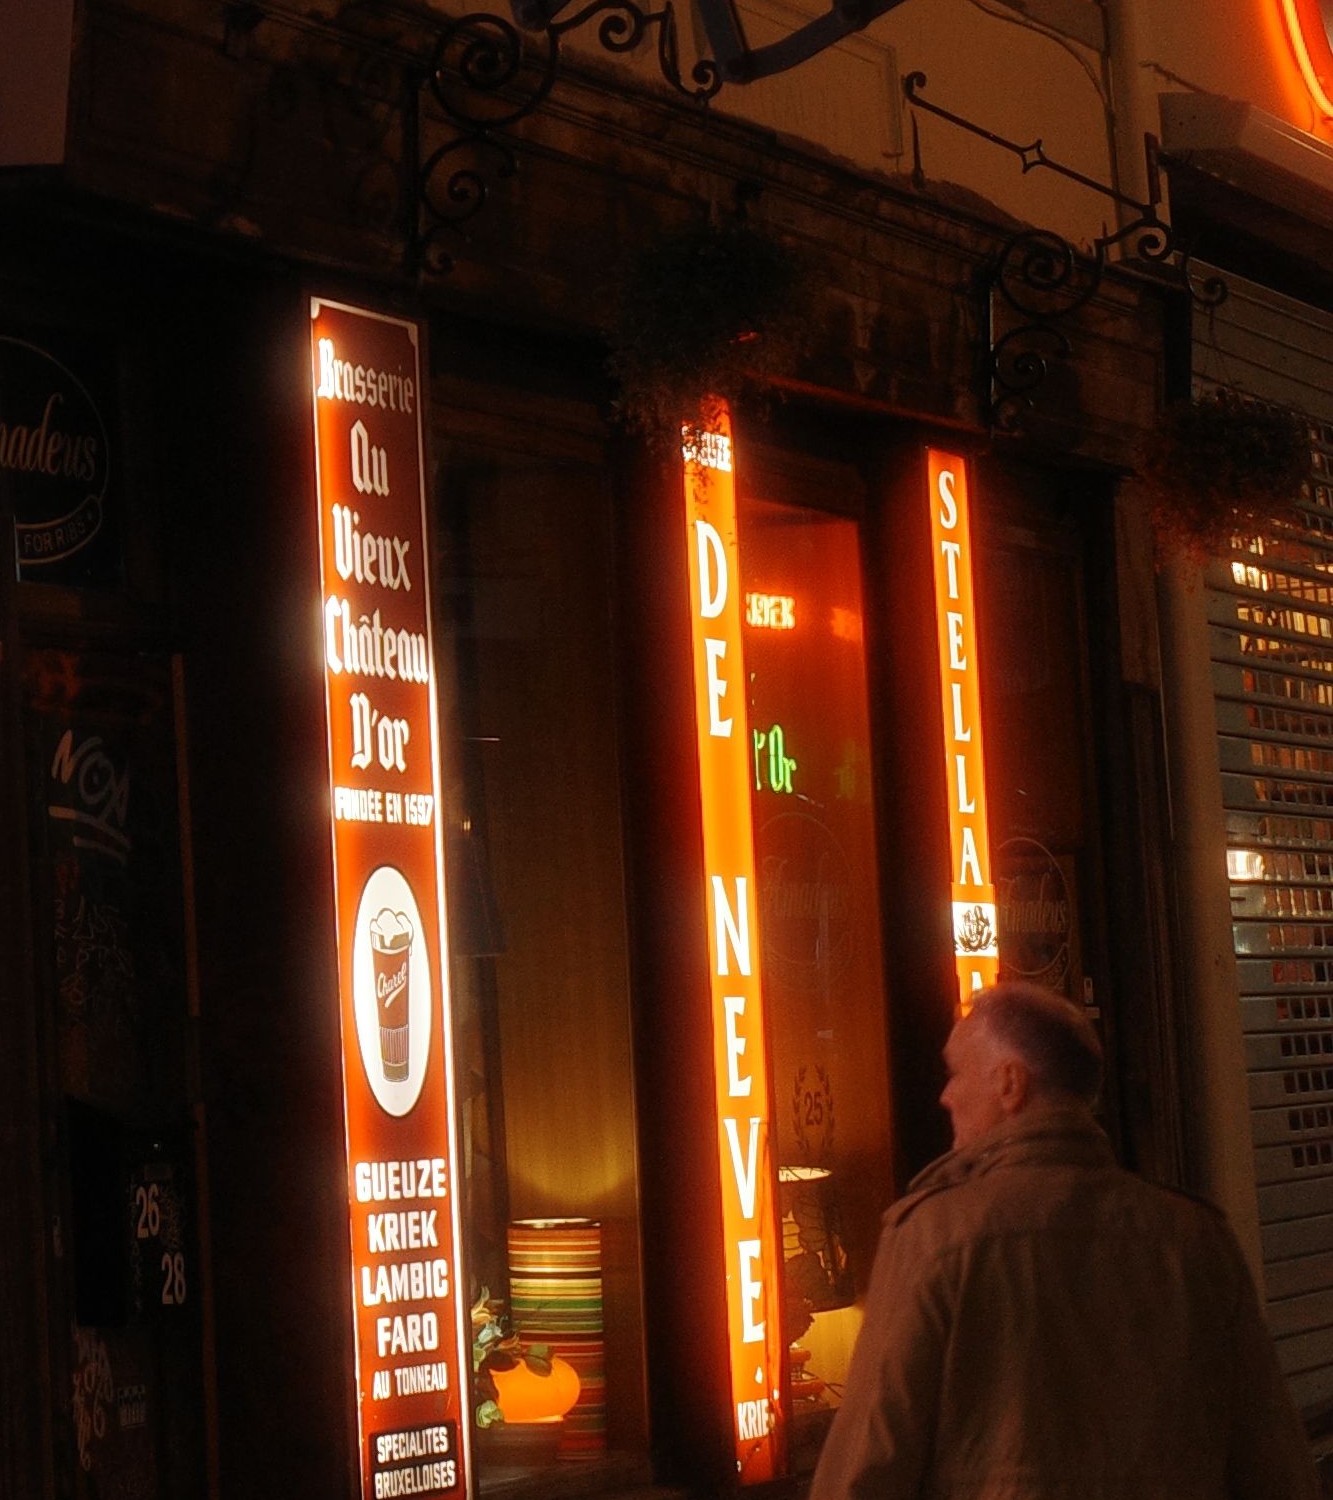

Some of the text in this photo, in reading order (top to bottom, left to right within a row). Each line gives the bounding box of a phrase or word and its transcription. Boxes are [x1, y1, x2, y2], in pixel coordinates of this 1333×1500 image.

[318, 338, 415, 413] Brasserie
[22, 530, 53, 555] FOR
[332, 503, 411, 591] Vieux
[325, 594, 429, 685] Château
[935, 467, 983, 888] STELLA
[350, 692, 409, 772] D'or
[386, 792, 403, 825] EN
[404, 793, 434, 827] 1597
[804, 1091, 825, 1127] 25
[355, 1158, 447, 1203] GUEUZE
[134, 1182, 161, 1241] 26
[366, 1209, 438, 1253] KRIEK
[160, 1250, 187, 1306] 28
[362, 1258, 449, 1306] LAMBIC
[376, 1312, 440, 1358] FARO
[372, 1361, 448, 1400] AU TONNEAU
[737, 1400, 770, 1441] KRIE
[376, 1425, 450, 1464] SPECIALITES
[374, 1459, 457, 1500] BRUXELLOISES
